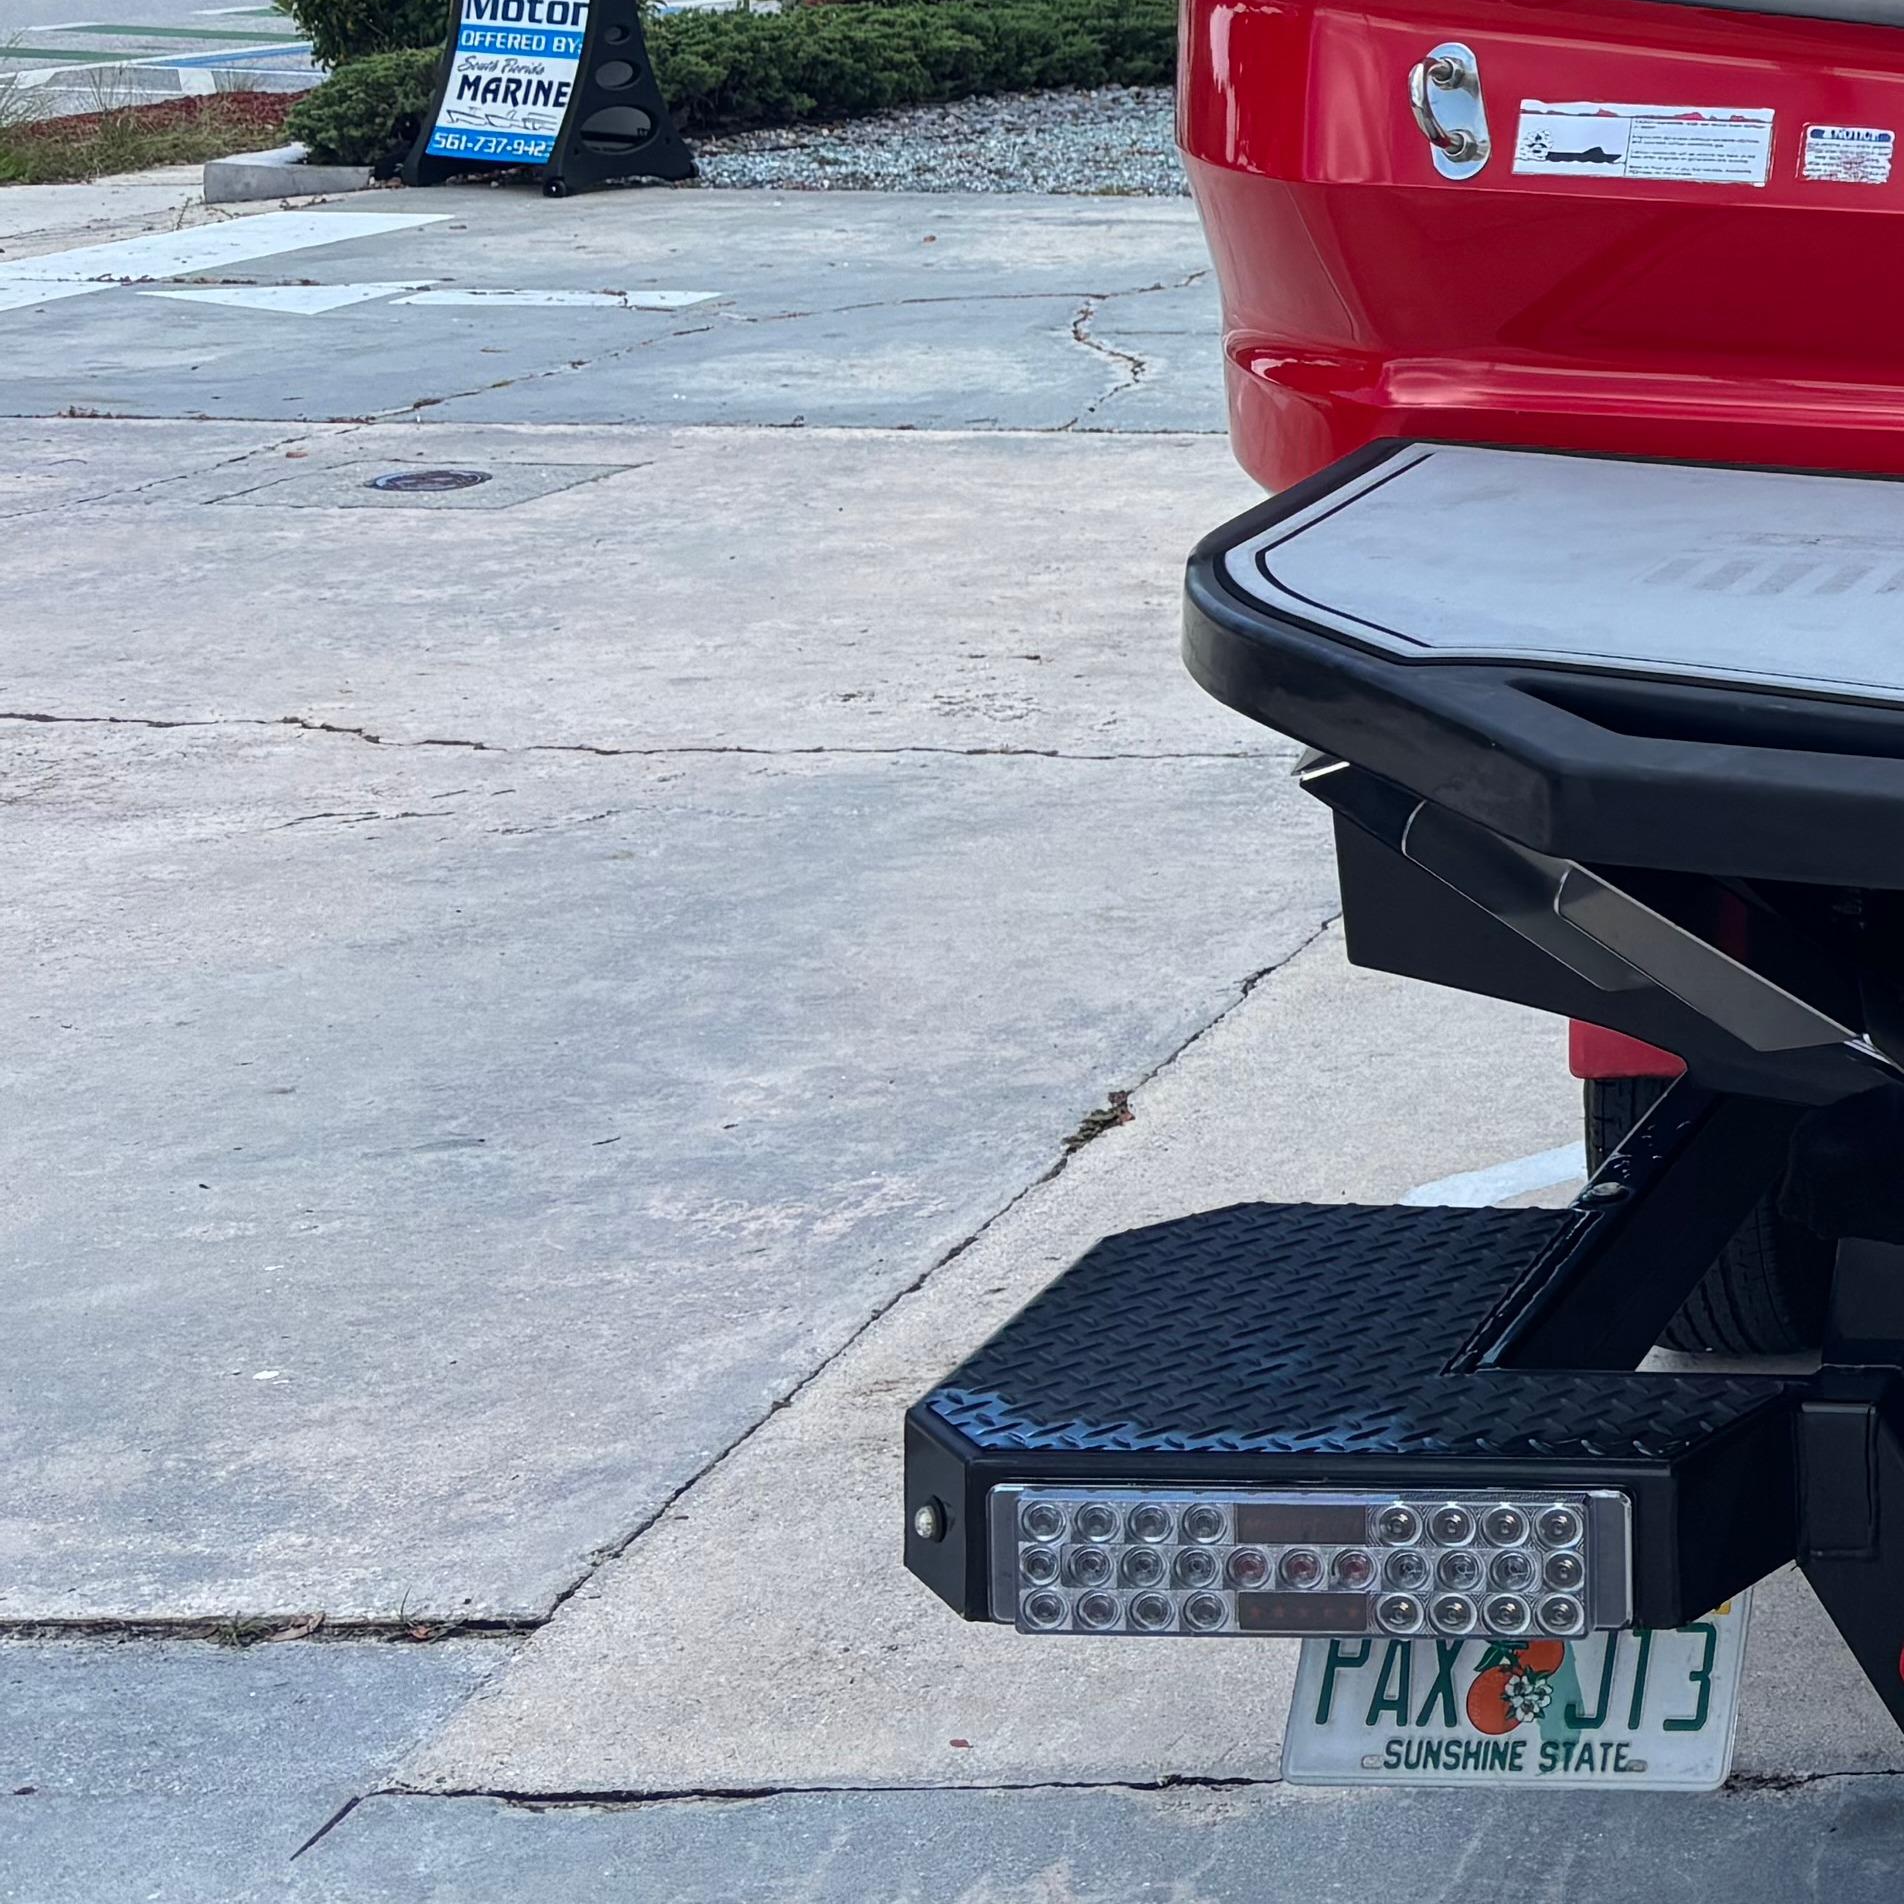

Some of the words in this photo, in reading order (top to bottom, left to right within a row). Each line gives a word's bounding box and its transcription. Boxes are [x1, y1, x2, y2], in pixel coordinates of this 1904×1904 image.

[461, 29, 546, 51] OFFERED
[456, 74, 572, 108] MARINE
[1315, 1639, 1465, 1728] PAX
[1564, 1622, 1717, 1731] J13
[1383, 1738, 1527, 1772] SUNSHINE
[1538, 1741, 1630, 1773] STATE
